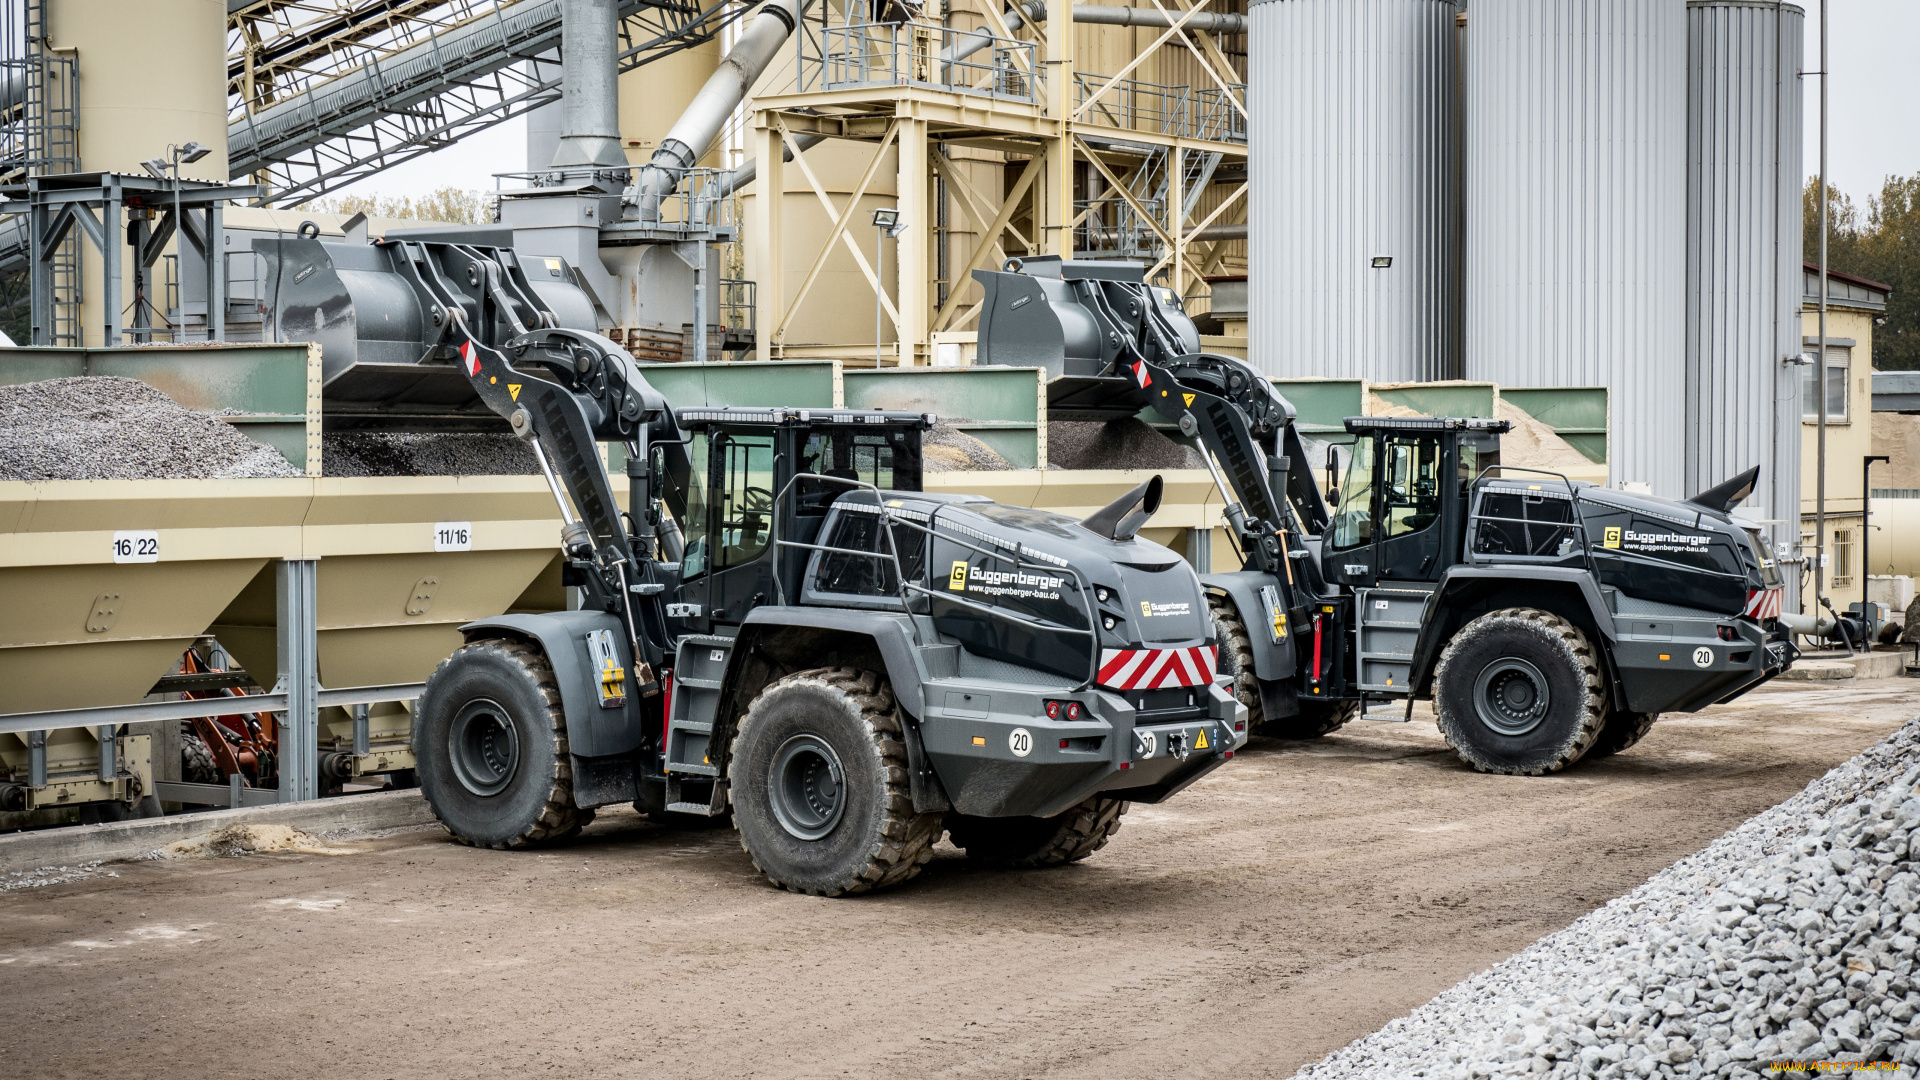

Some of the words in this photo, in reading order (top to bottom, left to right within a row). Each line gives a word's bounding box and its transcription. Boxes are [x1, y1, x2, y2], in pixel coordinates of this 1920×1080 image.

[539, 389, 614, 547] LIEBHERR
[438, 529, 468, 545] 11/16
[1624, 531, 1711, 545] Guggenberger
[114, 537, 157, 556] 16/22
[1624, 543, 1708, 553] www.guggenberger-bau.de
[970, 567, 1064, 589] Guggenberger
[968, 584, 1060, 600] www.guggenberger-bau.de
[1697, 650, 1709, 663] 20
[1013, 732, 1028, 751] 20
